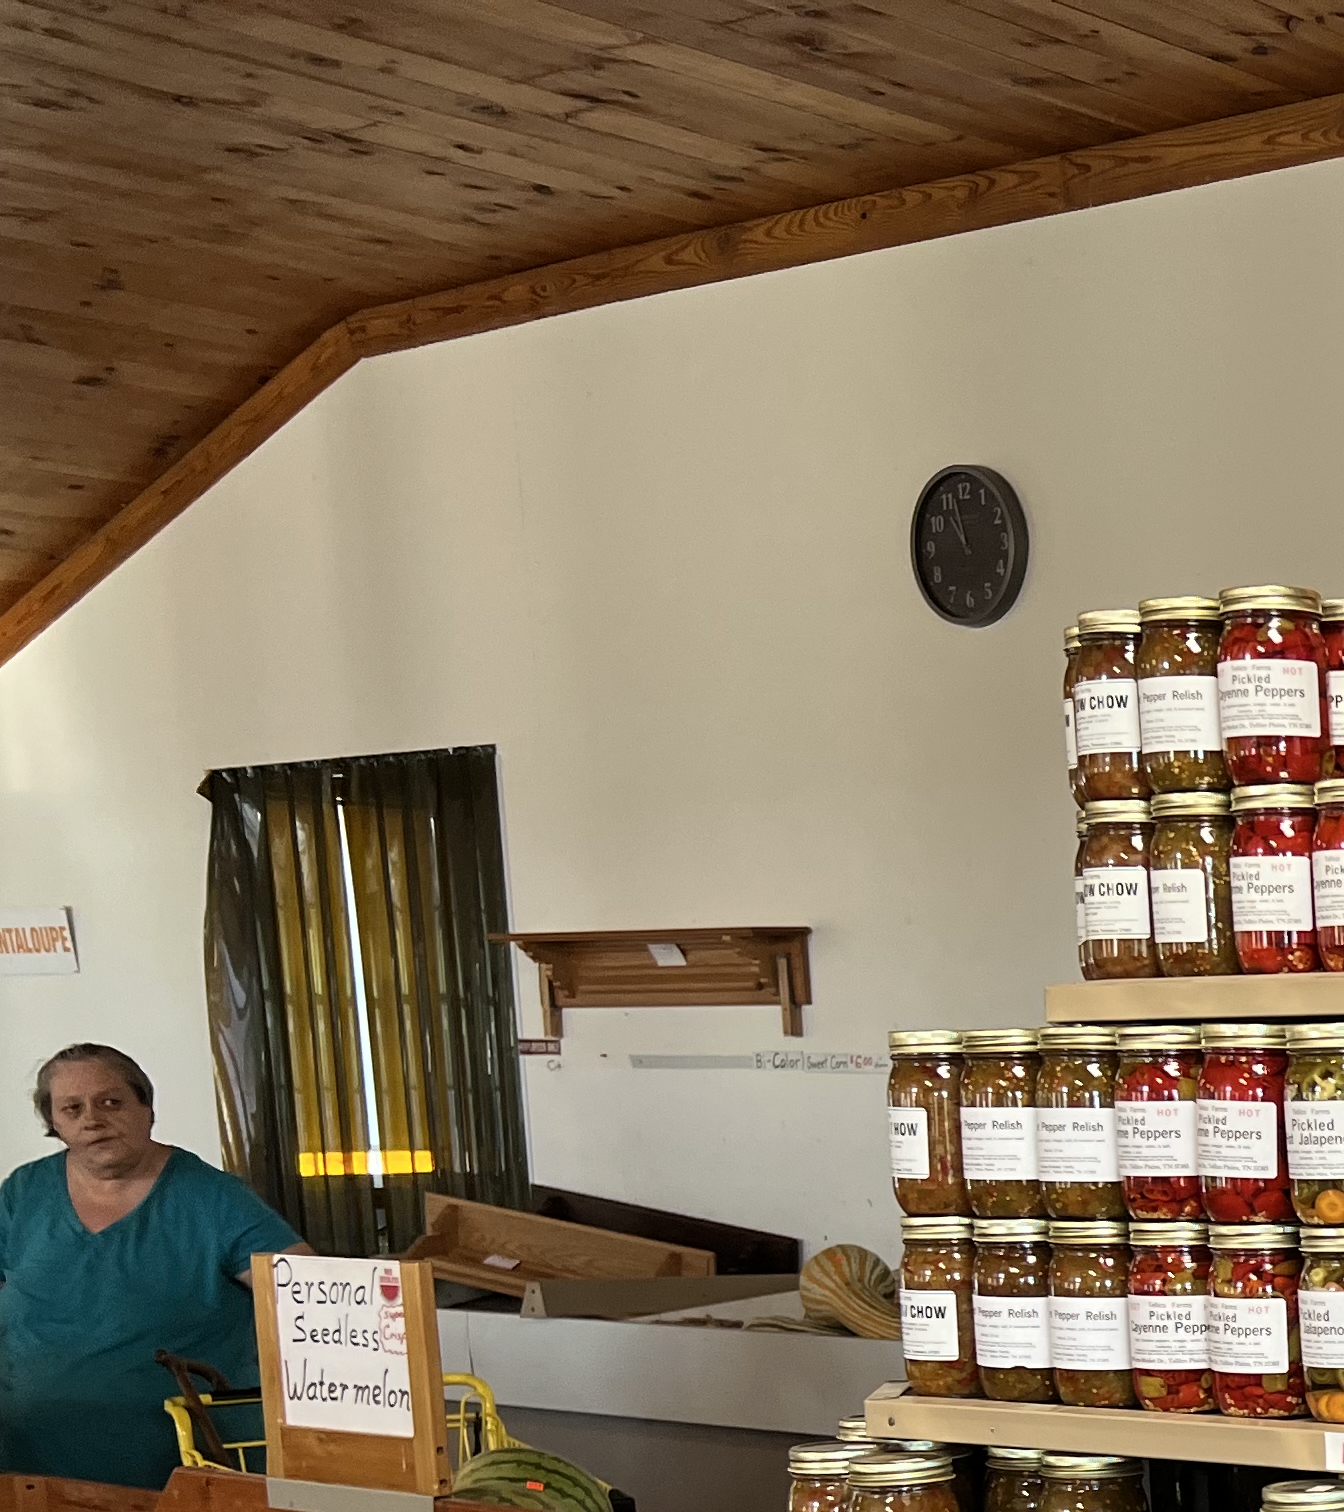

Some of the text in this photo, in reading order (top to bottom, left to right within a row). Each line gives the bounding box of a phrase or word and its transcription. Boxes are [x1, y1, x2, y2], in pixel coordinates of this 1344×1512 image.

[958, 482, 971, 499] 12
[930, 516, 944, 532] 10
[994, 508, 1002, 524] 2
[1001, 532, 1008, 550] 3
[927, 541, 935, 558] 9
[933, 566, 941, 583] 8
[996, 560, 1004, 576] 4
[966, 590, 974, 608] 6
[984, 583, 992, 599] 5
[1254, 685, 1306, 700] Peppers
[1098, 882, 1139, 898] CHOW
[273, 1257, 378, 1305] Personal
[910, 1305, 947, 1320] CHOW
[1148, 1310, 1192, 1322] Pickled
[292, 1312, 380, 1351] Seedless
[284, 1359, 410, 1411] Watermelon
